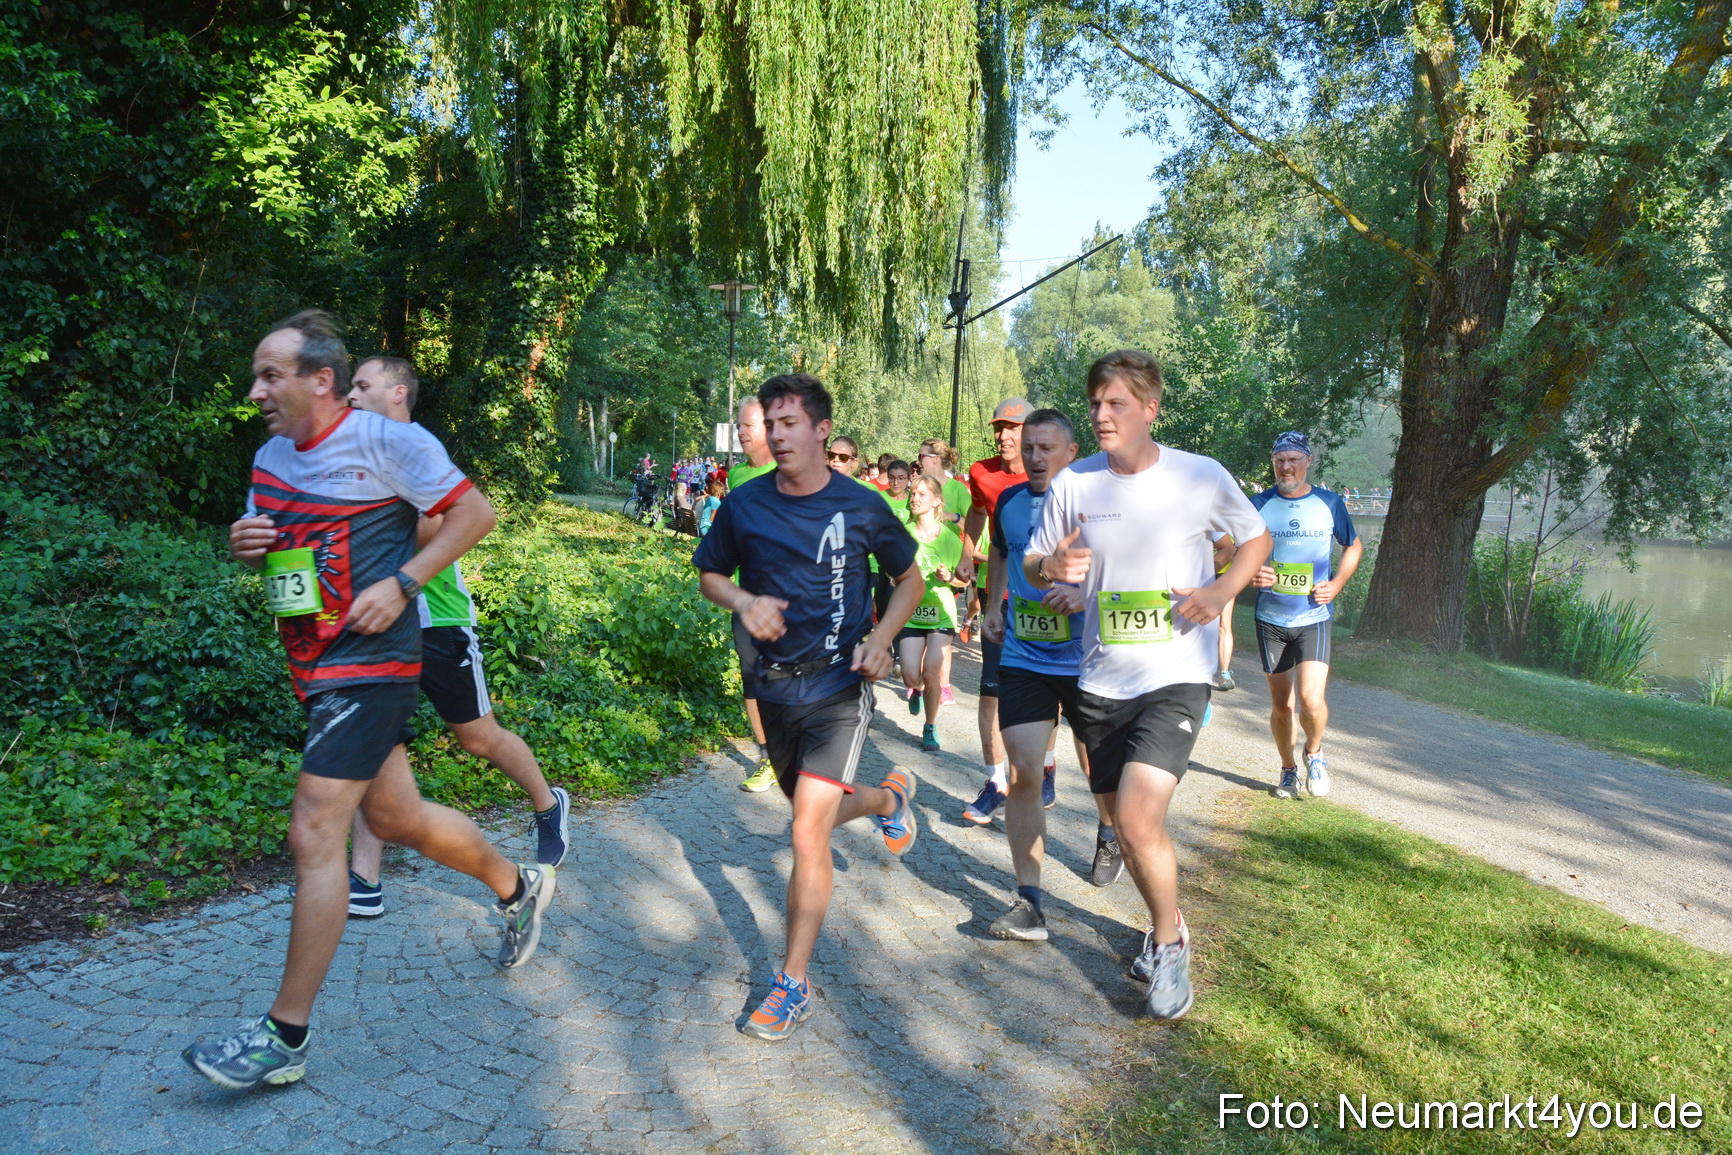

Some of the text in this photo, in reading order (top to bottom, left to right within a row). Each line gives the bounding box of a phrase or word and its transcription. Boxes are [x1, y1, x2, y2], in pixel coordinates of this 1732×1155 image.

[1270, 530, 1324, 538] CHABMÜLLER
[1275, 573, 1307, 587] 1769
[912, 606, 936, 617] 054
[1018, 613, 1059, 631] 1761
[1108, 609, 1159, 630] 1791
